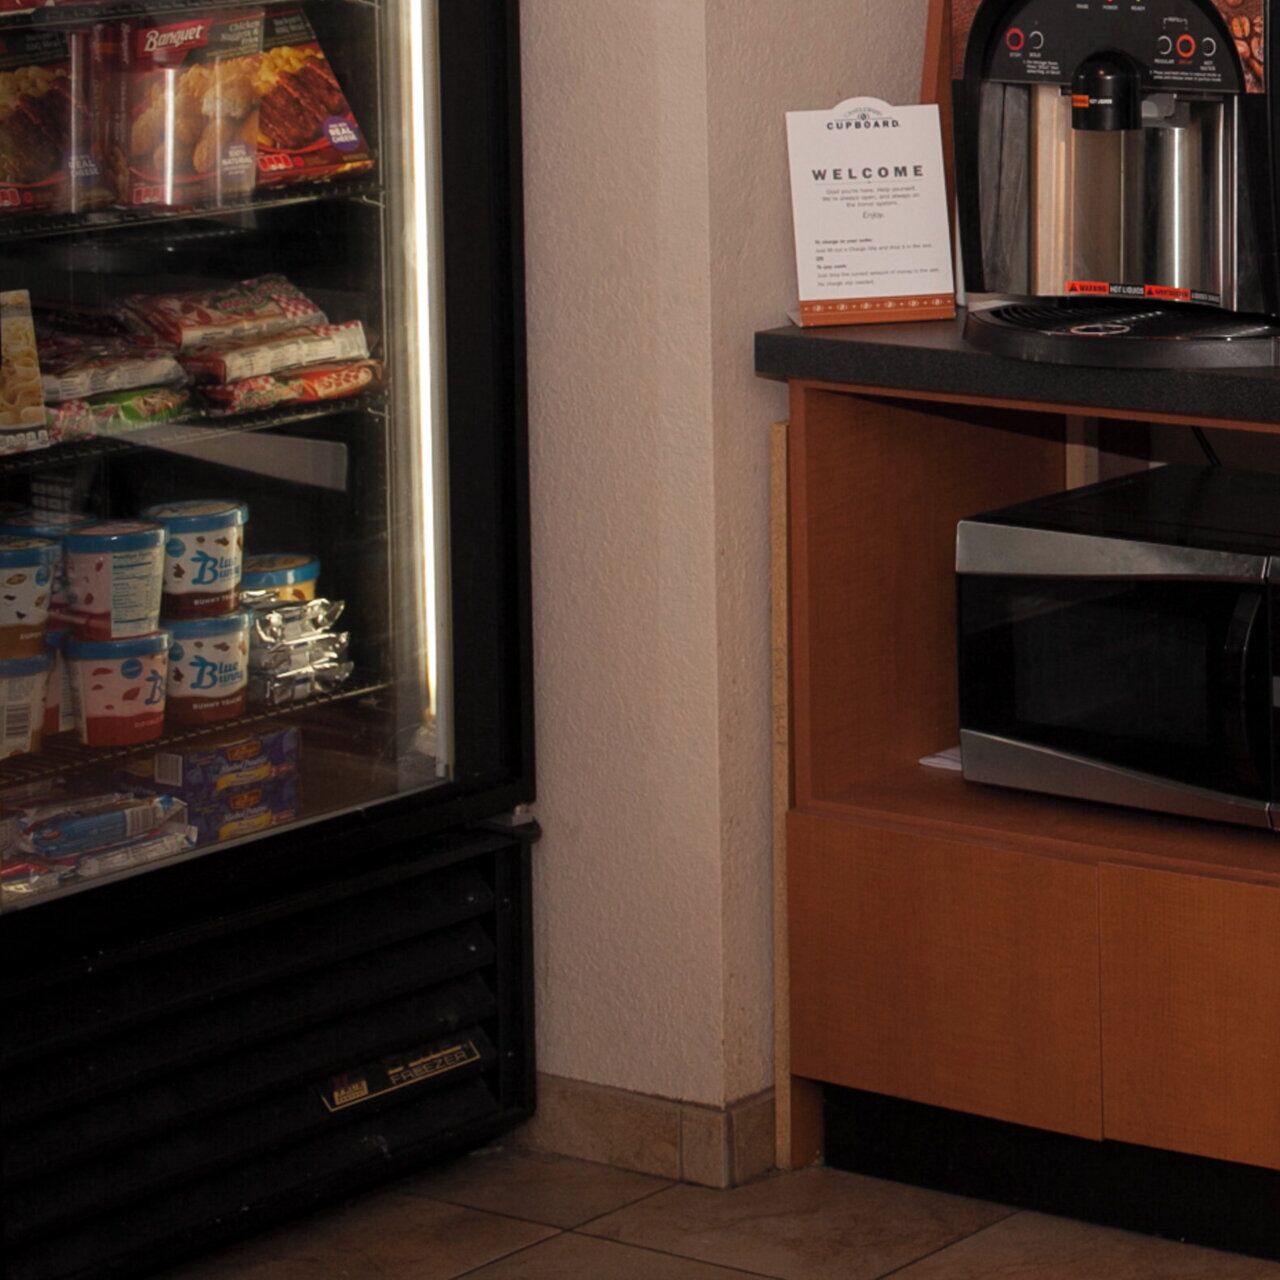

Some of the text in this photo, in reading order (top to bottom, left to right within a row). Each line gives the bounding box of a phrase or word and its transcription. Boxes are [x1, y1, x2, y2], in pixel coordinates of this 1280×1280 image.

[145, 25, 205, 51] Banquet
[827, 120, 899, 131] CUPBOARD
[812, 164, 924, 182] WELCOME
